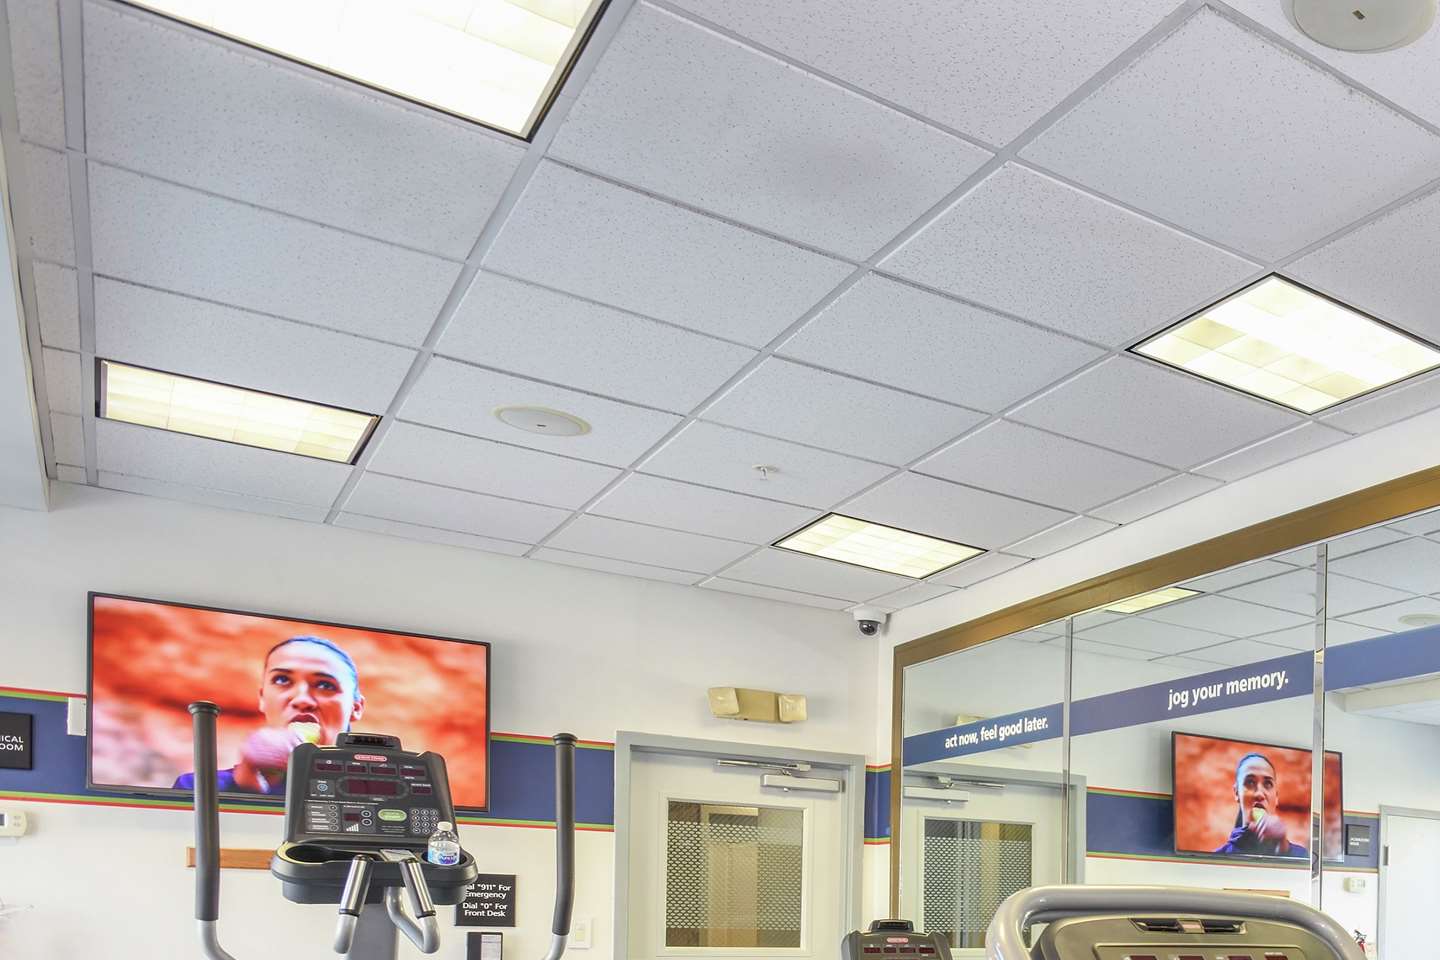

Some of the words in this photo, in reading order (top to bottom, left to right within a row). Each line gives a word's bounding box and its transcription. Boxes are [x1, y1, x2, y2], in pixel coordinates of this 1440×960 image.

[1167, 689, 1189, 710] jog
[1192, 682, 1223, 706] your
[1226, 670, 1289, 695] memory.
[944, 734, 958, 748] act
[959, 731, 979, 744] now,
[980, 724, 997, 741] feel
[999, 718, 1022, 741] good
[1024, 717, 1048, 732] later.
[0, 735, 24, 743] ICAL
[0, 743, 24, 751] OOM
[465, 891, 507, 899] Emergency
[464, 909, 485, 917] Front
